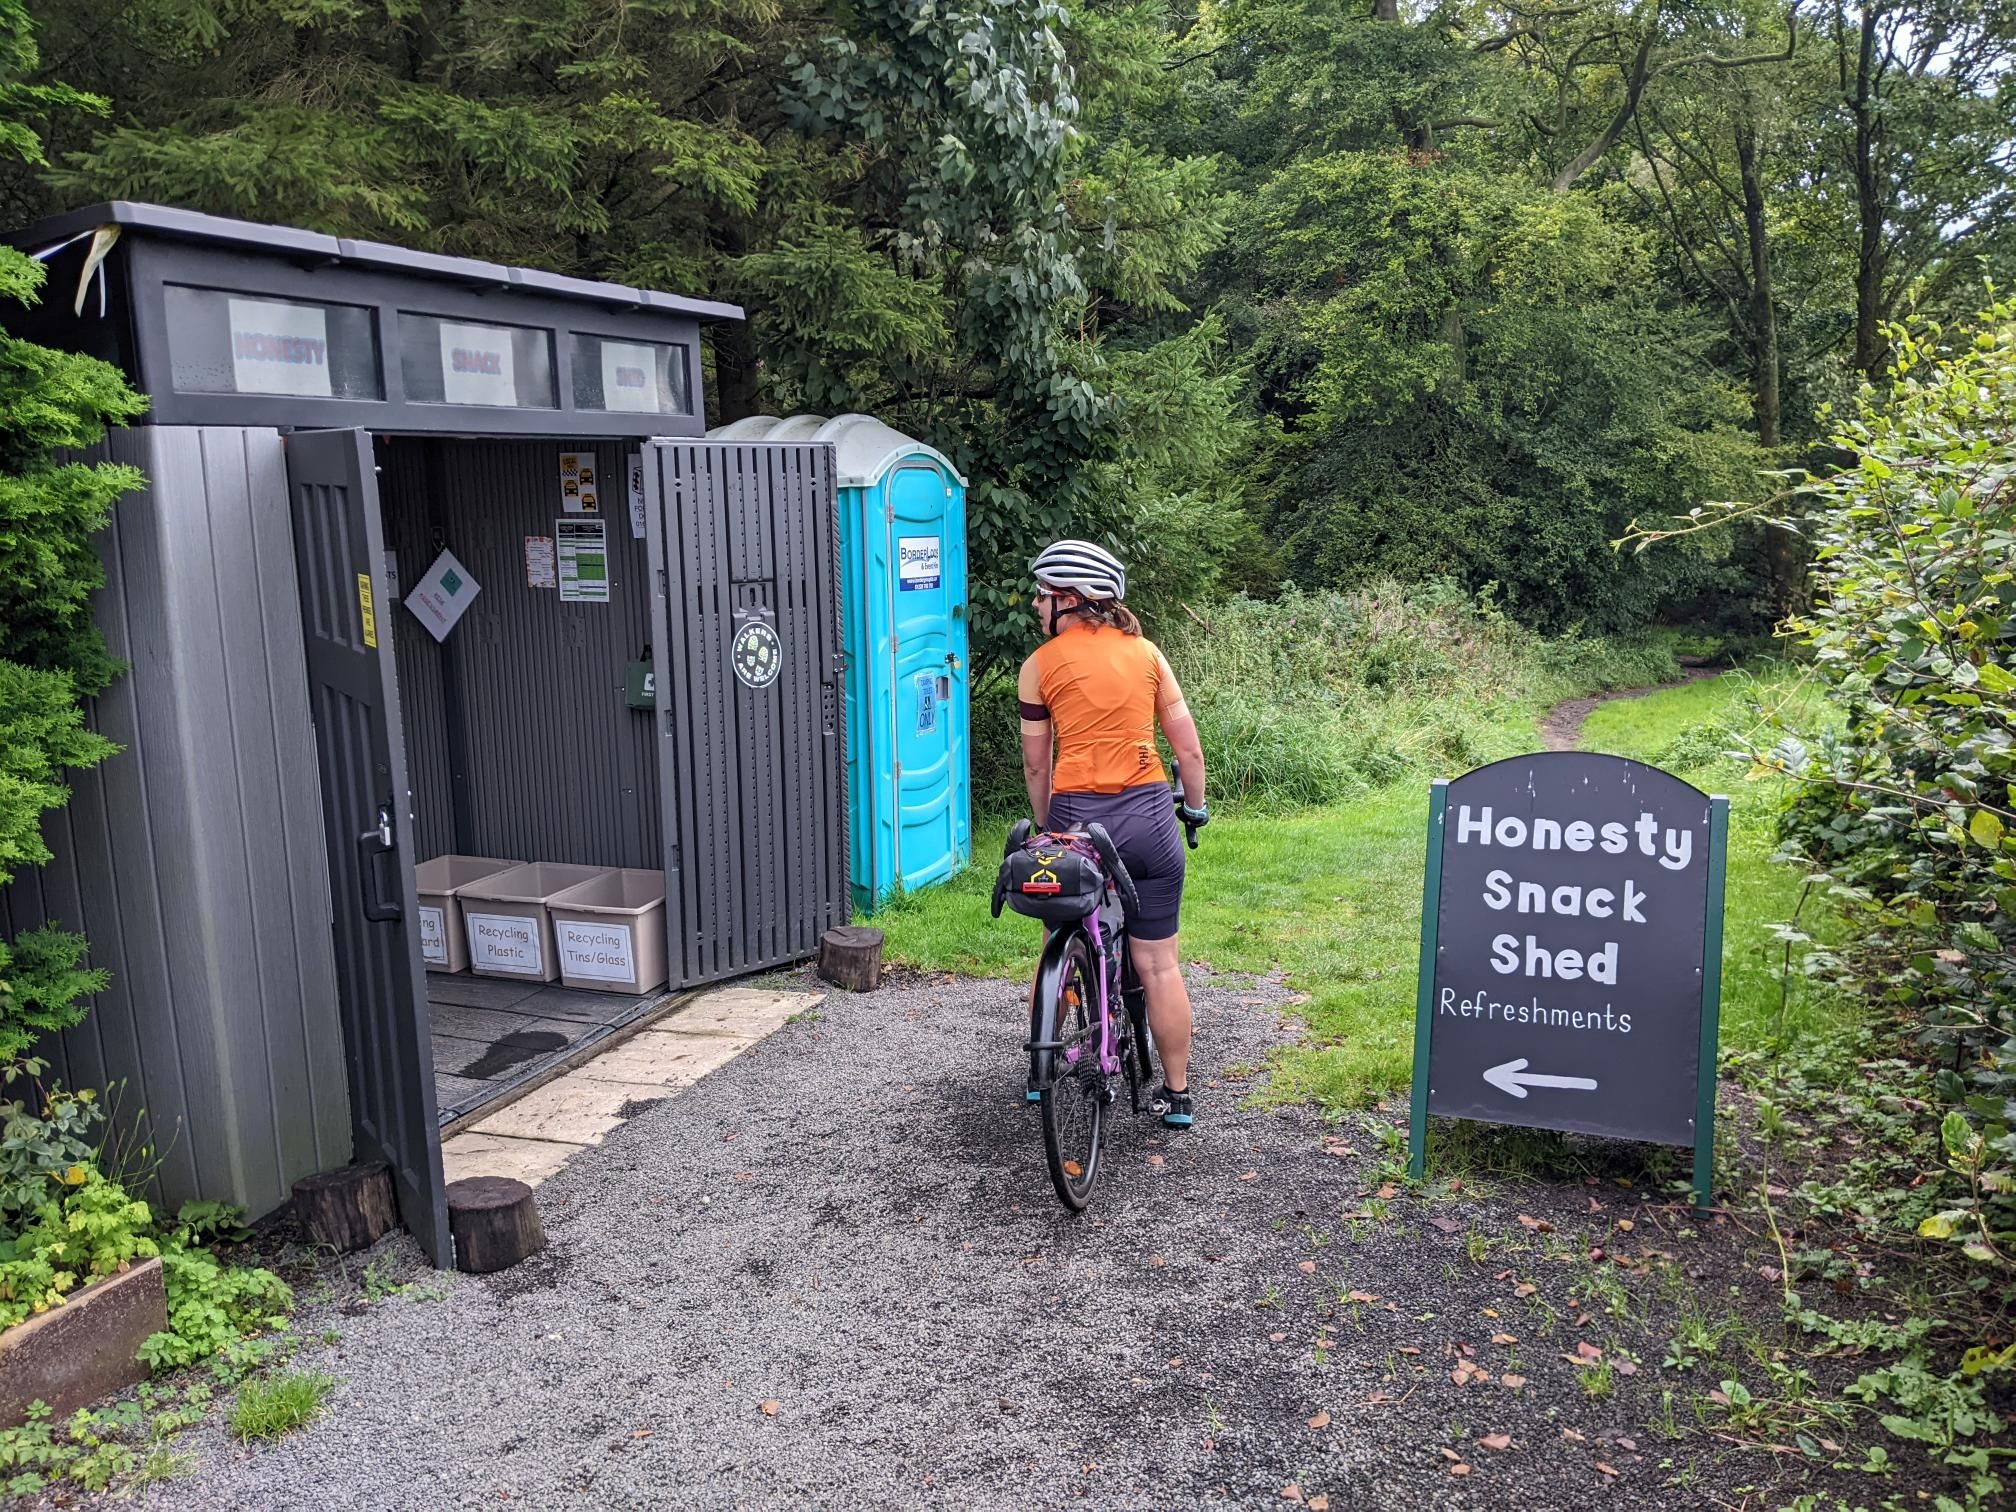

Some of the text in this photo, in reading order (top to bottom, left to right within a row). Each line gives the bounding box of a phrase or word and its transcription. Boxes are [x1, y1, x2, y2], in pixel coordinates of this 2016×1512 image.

[233, 332, 325, 365] HONESTY
[737, 628, 772, 651] WALKERS
[738, 649, 778, 682] ARE WELCOME
[920, 712, 935, 728] ONLY
[1457, 805, 1692, 870] Honesty
[1483, 869, 1647, 923] Snack
[478, 925, 529, 943] Recycling
[567, 931, 621, 949] Recycling
[487, 944, 525, 958] Plastic
[567, 950, 626, 966] Tins/Glass
[1490, 933, 1619, 985] Shed
[1440, 987, 1632, 1033] Refreshments
